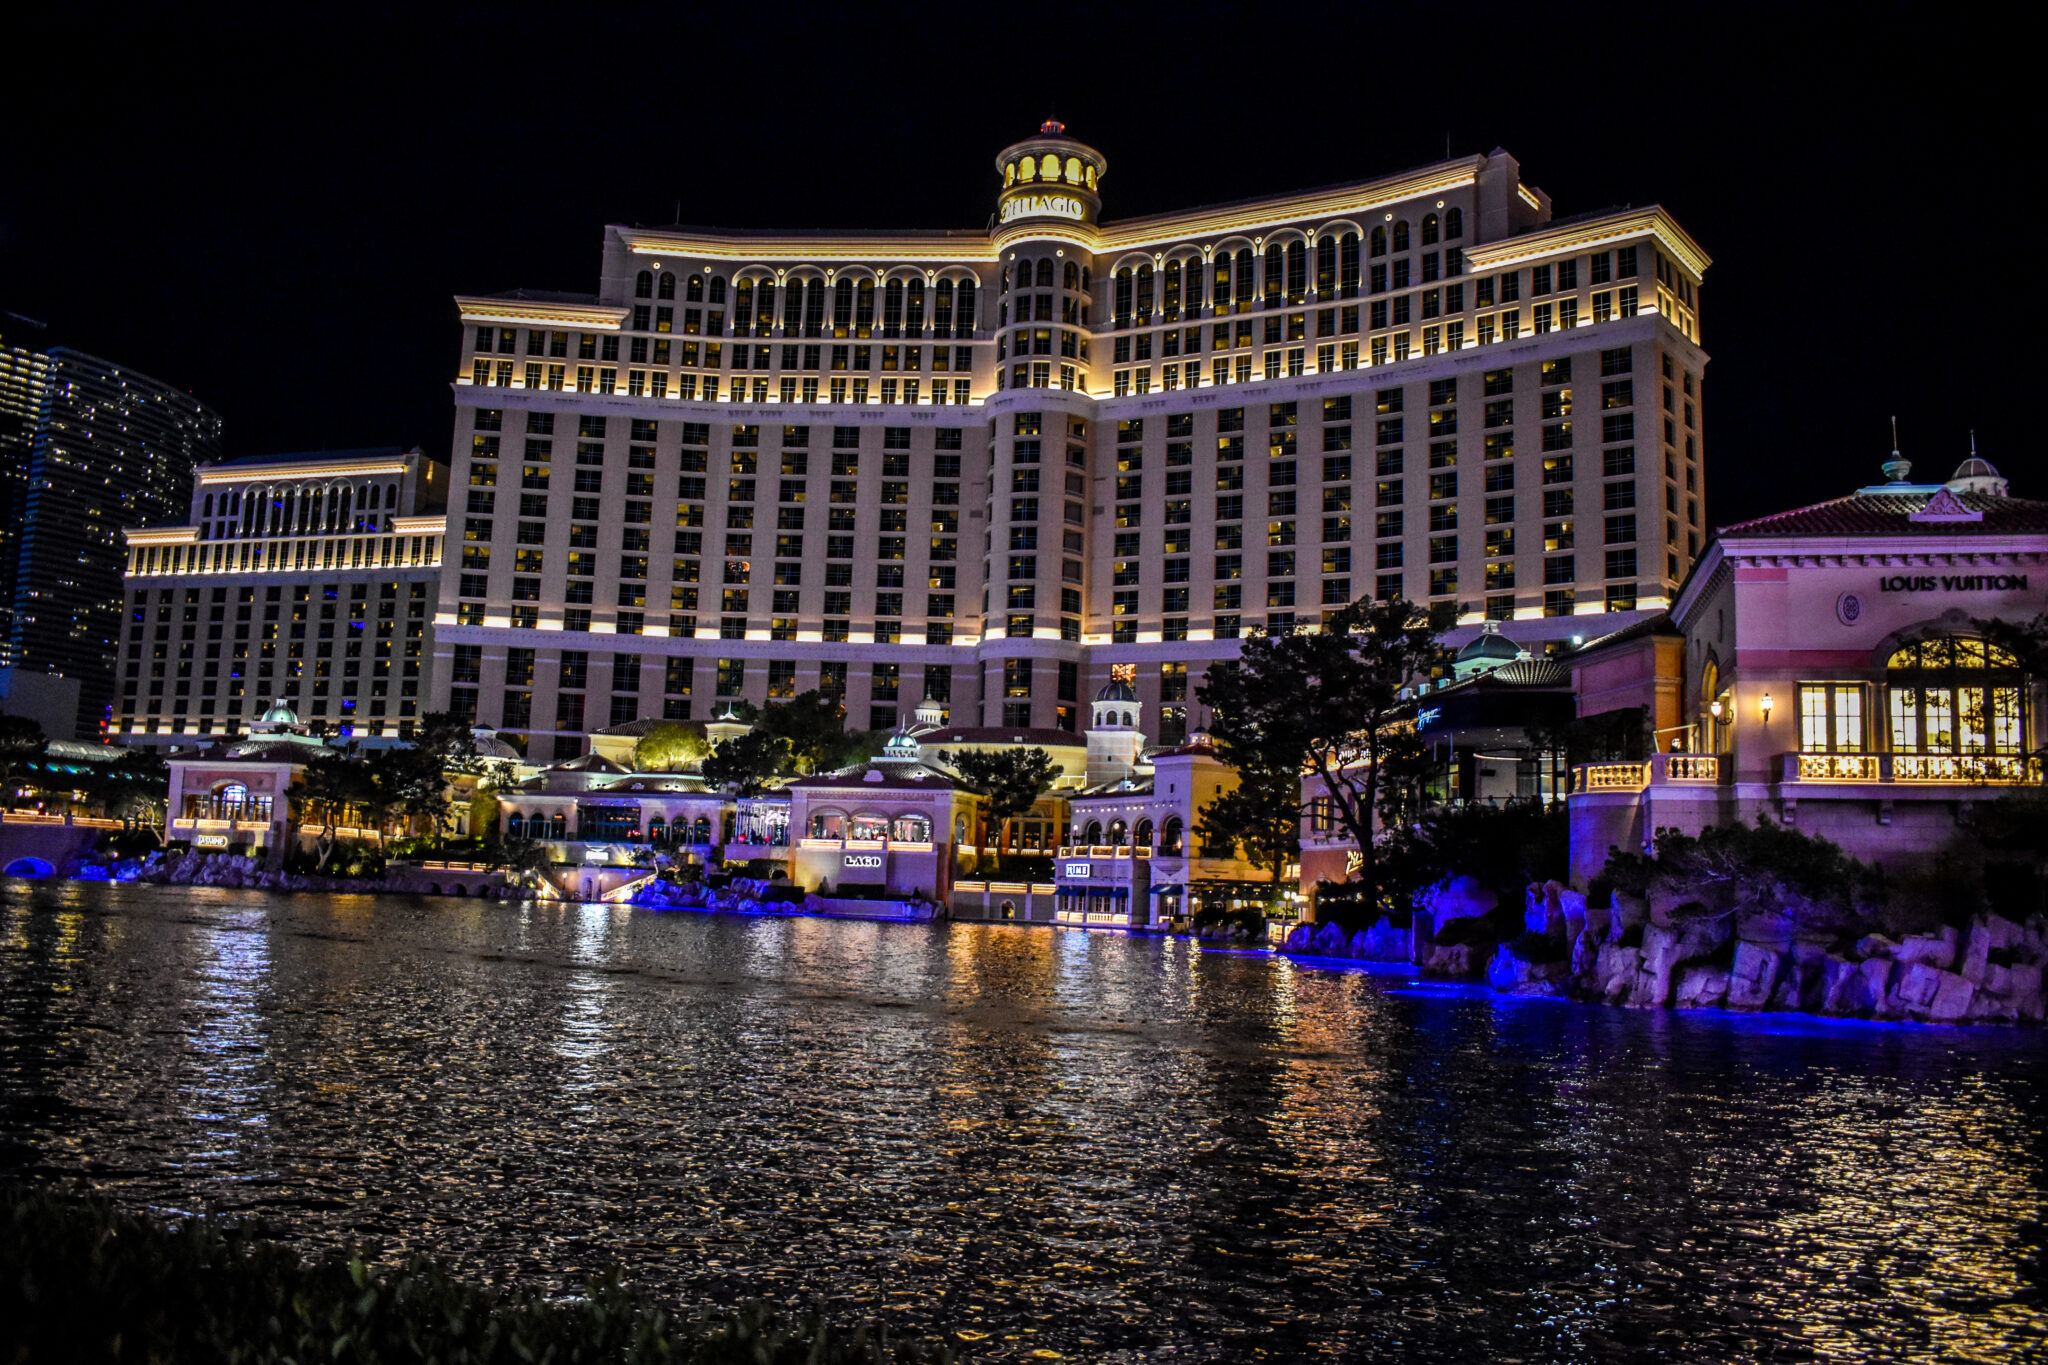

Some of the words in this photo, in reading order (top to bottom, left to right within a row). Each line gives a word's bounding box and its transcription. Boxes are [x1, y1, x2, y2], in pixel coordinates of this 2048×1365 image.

[1880, 576, 1937, 592] LOUIS
[1940, 575, 2028, 591] VUITTON
[845, 856, 881, 867] LAGO
